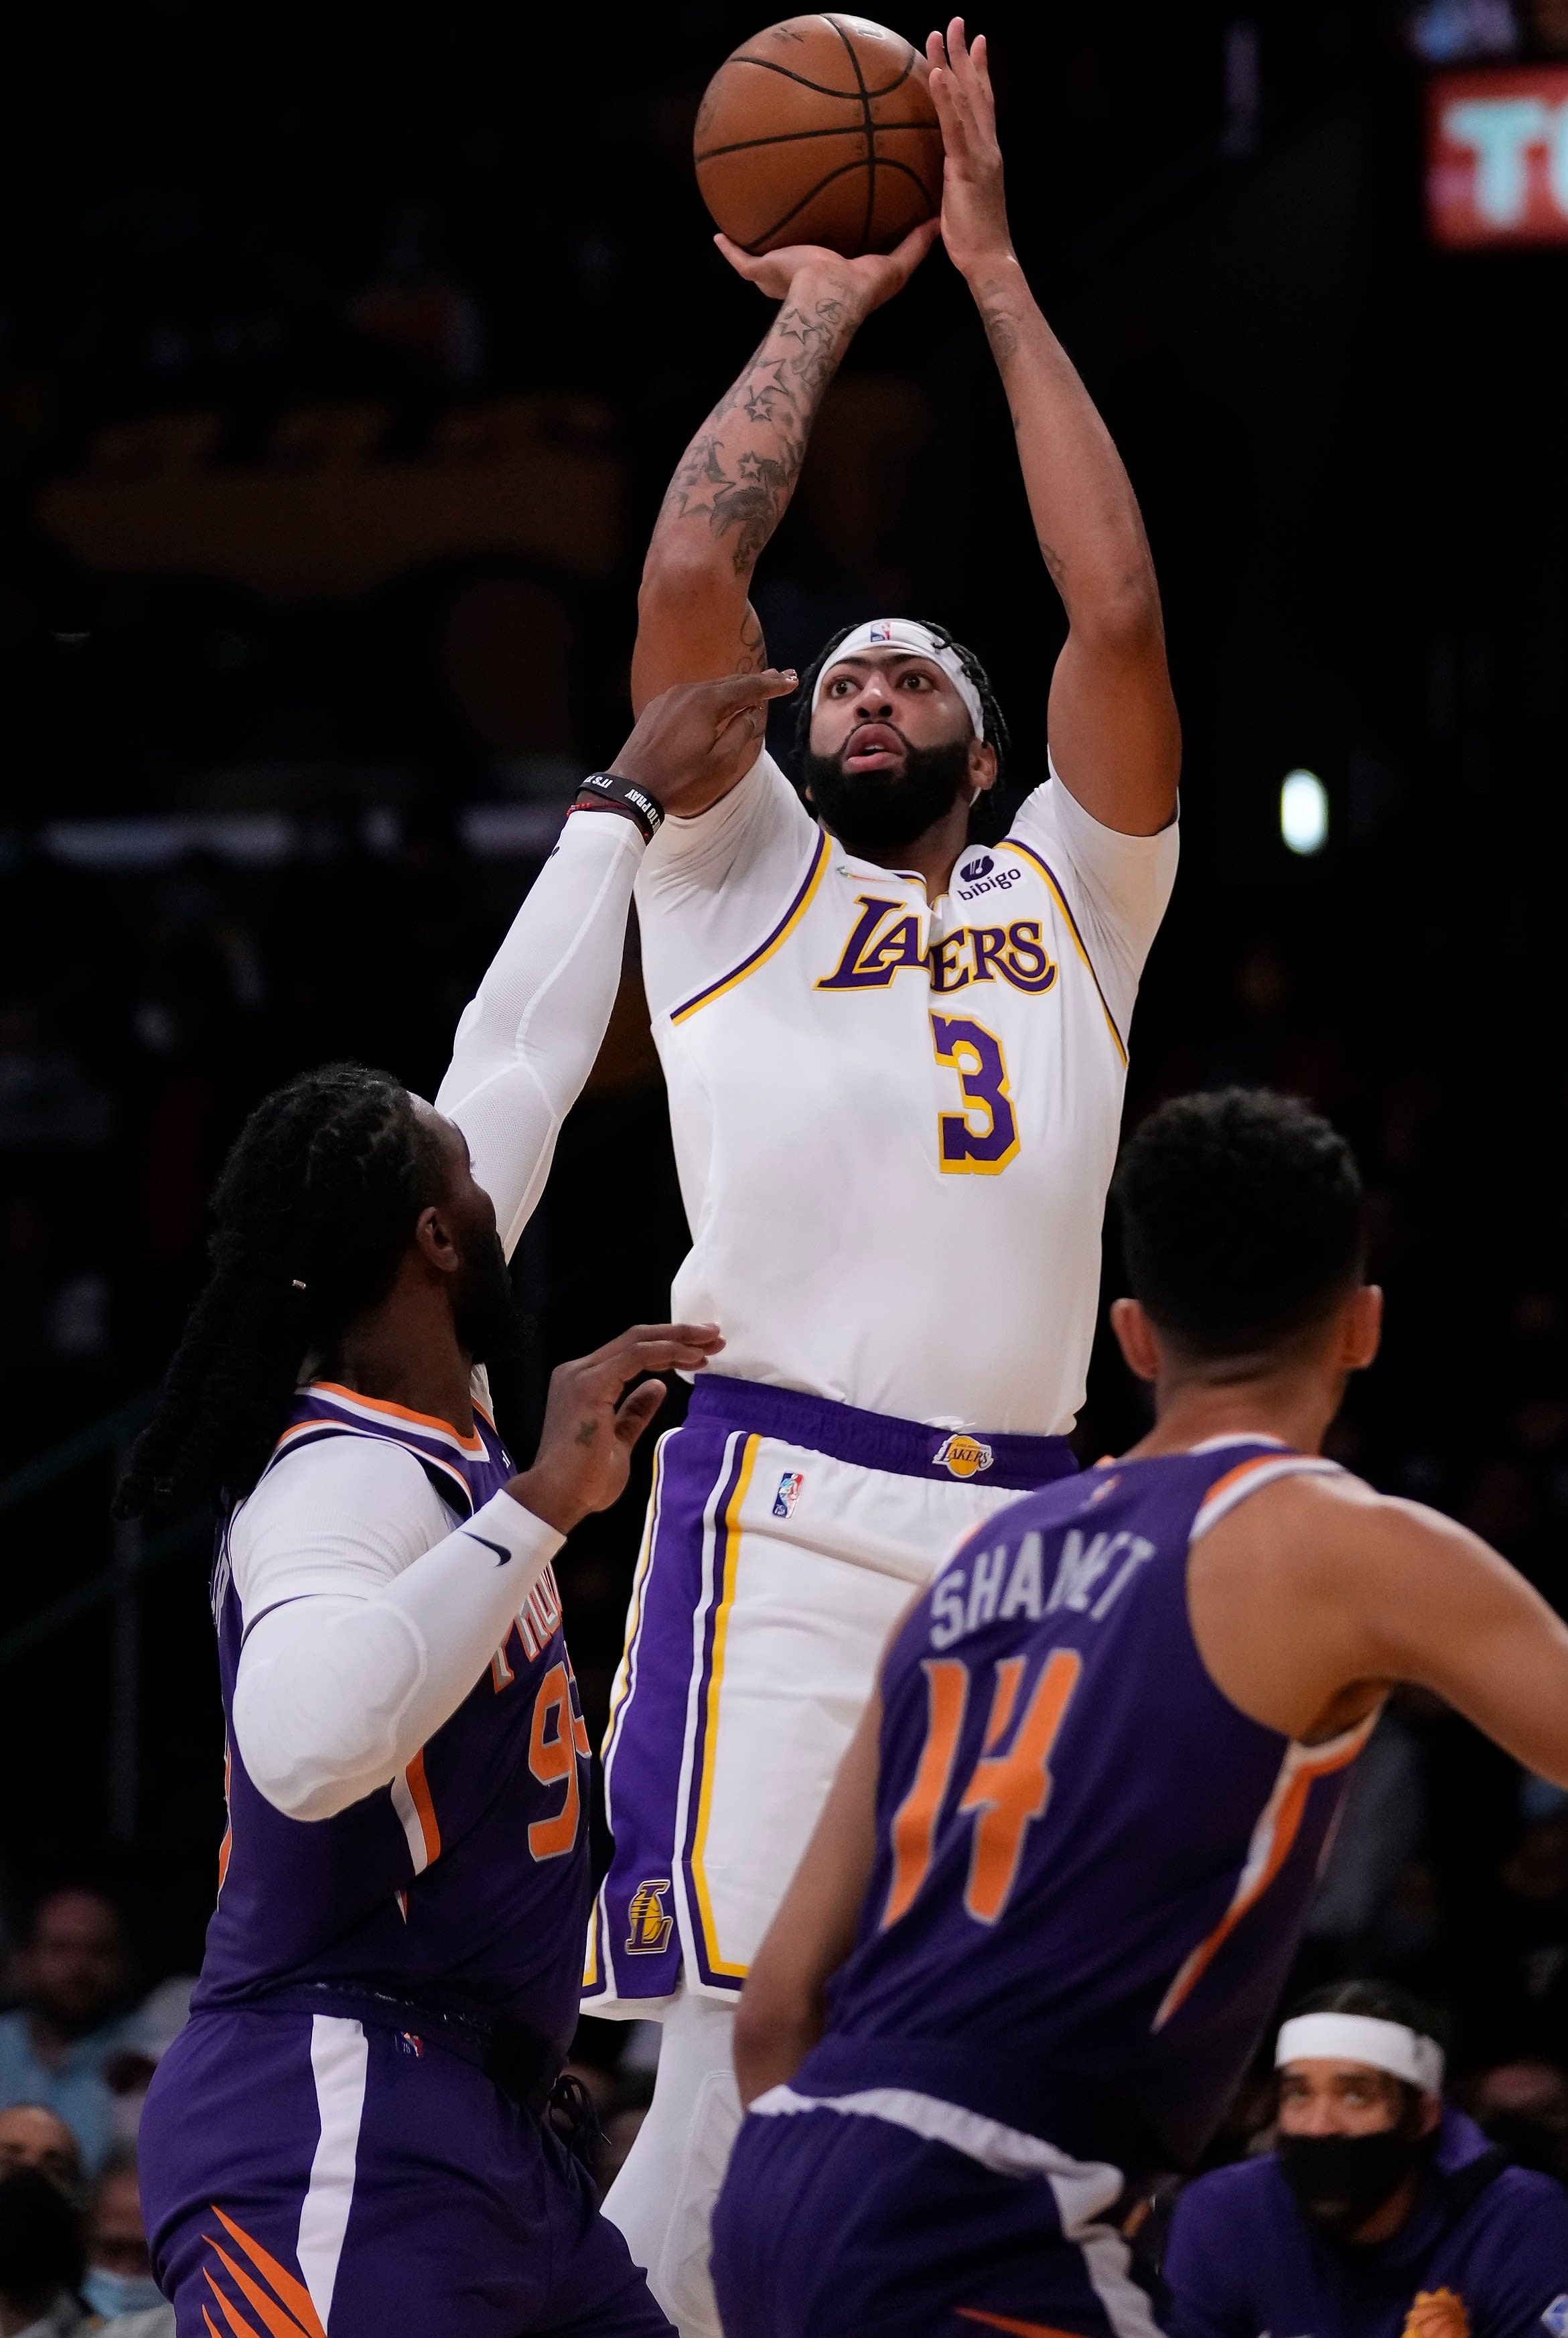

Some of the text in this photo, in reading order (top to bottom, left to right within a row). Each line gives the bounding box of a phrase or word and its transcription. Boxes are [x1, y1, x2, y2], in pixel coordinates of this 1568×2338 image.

[1440, 97, 1568, 230] T
[624, 788, 652, 813] PRAY
[646, 808, 658, 825] TO
[957, 869, 1021, 900] bibigo
[812, 894, 1058, 995] LAERS
[928, 1008, 1021, 1176] 3
[935, 1441, 993, 1469] LAKERS
[877, 1647, 1083, 1930] 14
